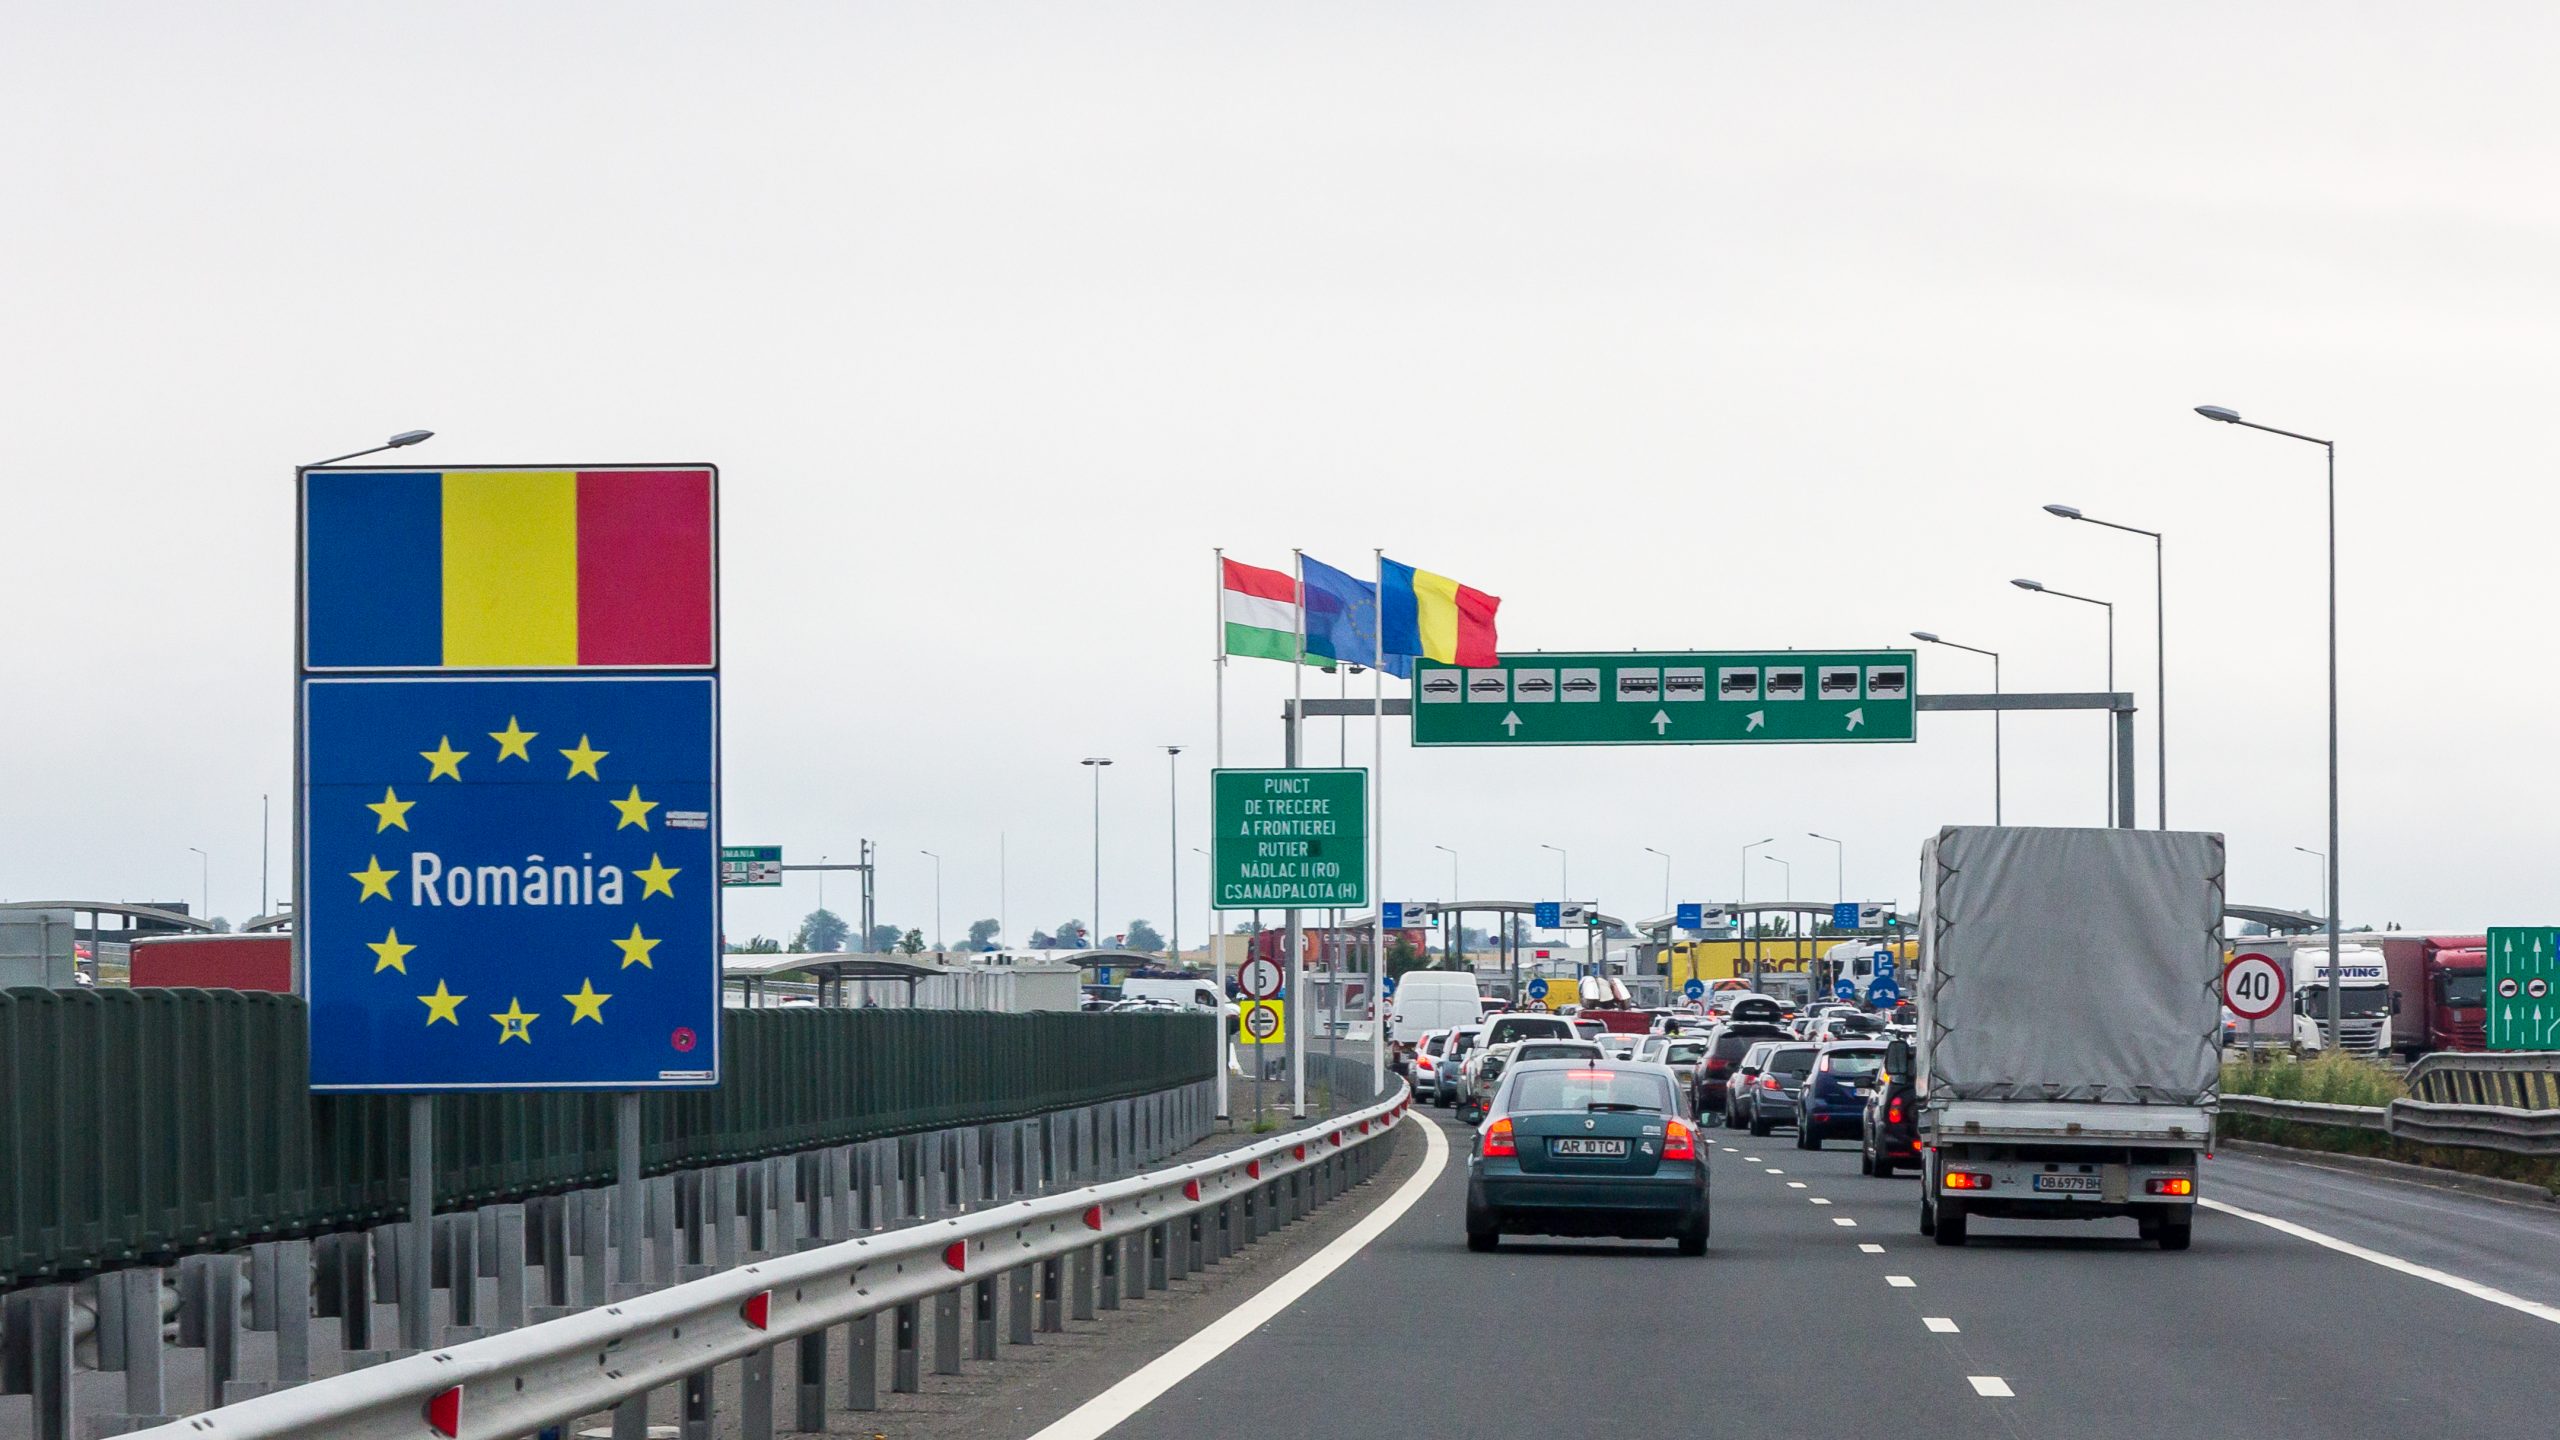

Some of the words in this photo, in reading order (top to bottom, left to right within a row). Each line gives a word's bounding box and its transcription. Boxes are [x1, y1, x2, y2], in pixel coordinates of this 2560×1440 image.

[1264, 778, 1310, 794] PUNCT
[1244, 799, 1263, 815] DE
[1268, 799, 1331, 815] TRECERE
[1240, 820, 1250, 836] A
[1254, 820, 1336, 836] FRONTIEREI
[1258, 841, 1309, 857] RUTIER
[1301, 862, 1309, 878] II
[1312, 862, 1340, 878] (RO)
[411, 851, 624, 907] România
[1338, 883, 1357, 899] (H)
[1879, 954, 1889, 968] P
[2317, 967, 2381, 978] MVING
[2236, 972, 2269, 1001] 40
[1561, 1141, 1580, 1152] AR
[1584, 1141, 1596, 1153] 10
[1599, 1141, 1621, 1153] TCA
